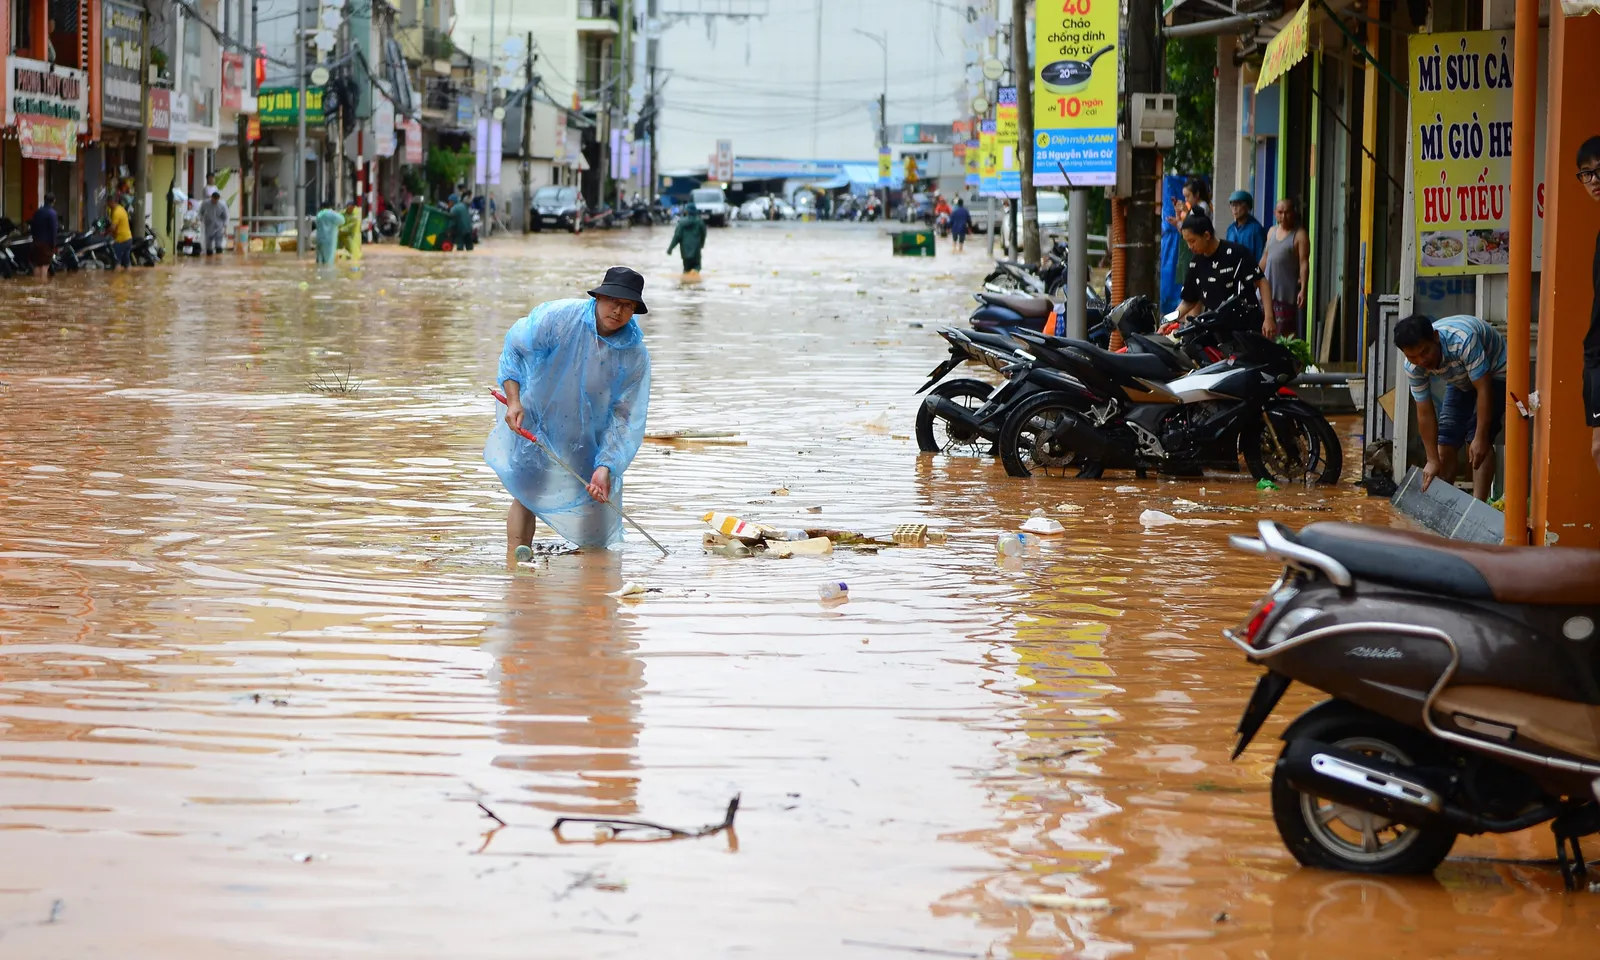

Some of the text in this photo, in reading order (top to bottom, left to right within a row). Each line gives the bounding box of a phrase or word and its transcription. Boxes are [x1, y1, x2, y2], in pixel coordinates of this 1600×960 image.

[1063, 0, 1091, 15] 40
[1062, 18, 1091, 29] Chảo
[1047, 31, 1105, 44] chống dính
[1060, 44, 1094, 57] đáy từ
[1418, 36, 1514, 92] MÌ SỦI CẢ
[1057, 97, 1081, 118] 10
[1420, 112, 1513, 161] MÌ GIÒ HE
[1423, 170, 1452, 224] HỦ
[1457, 167, 1504, 222] TIẾU
